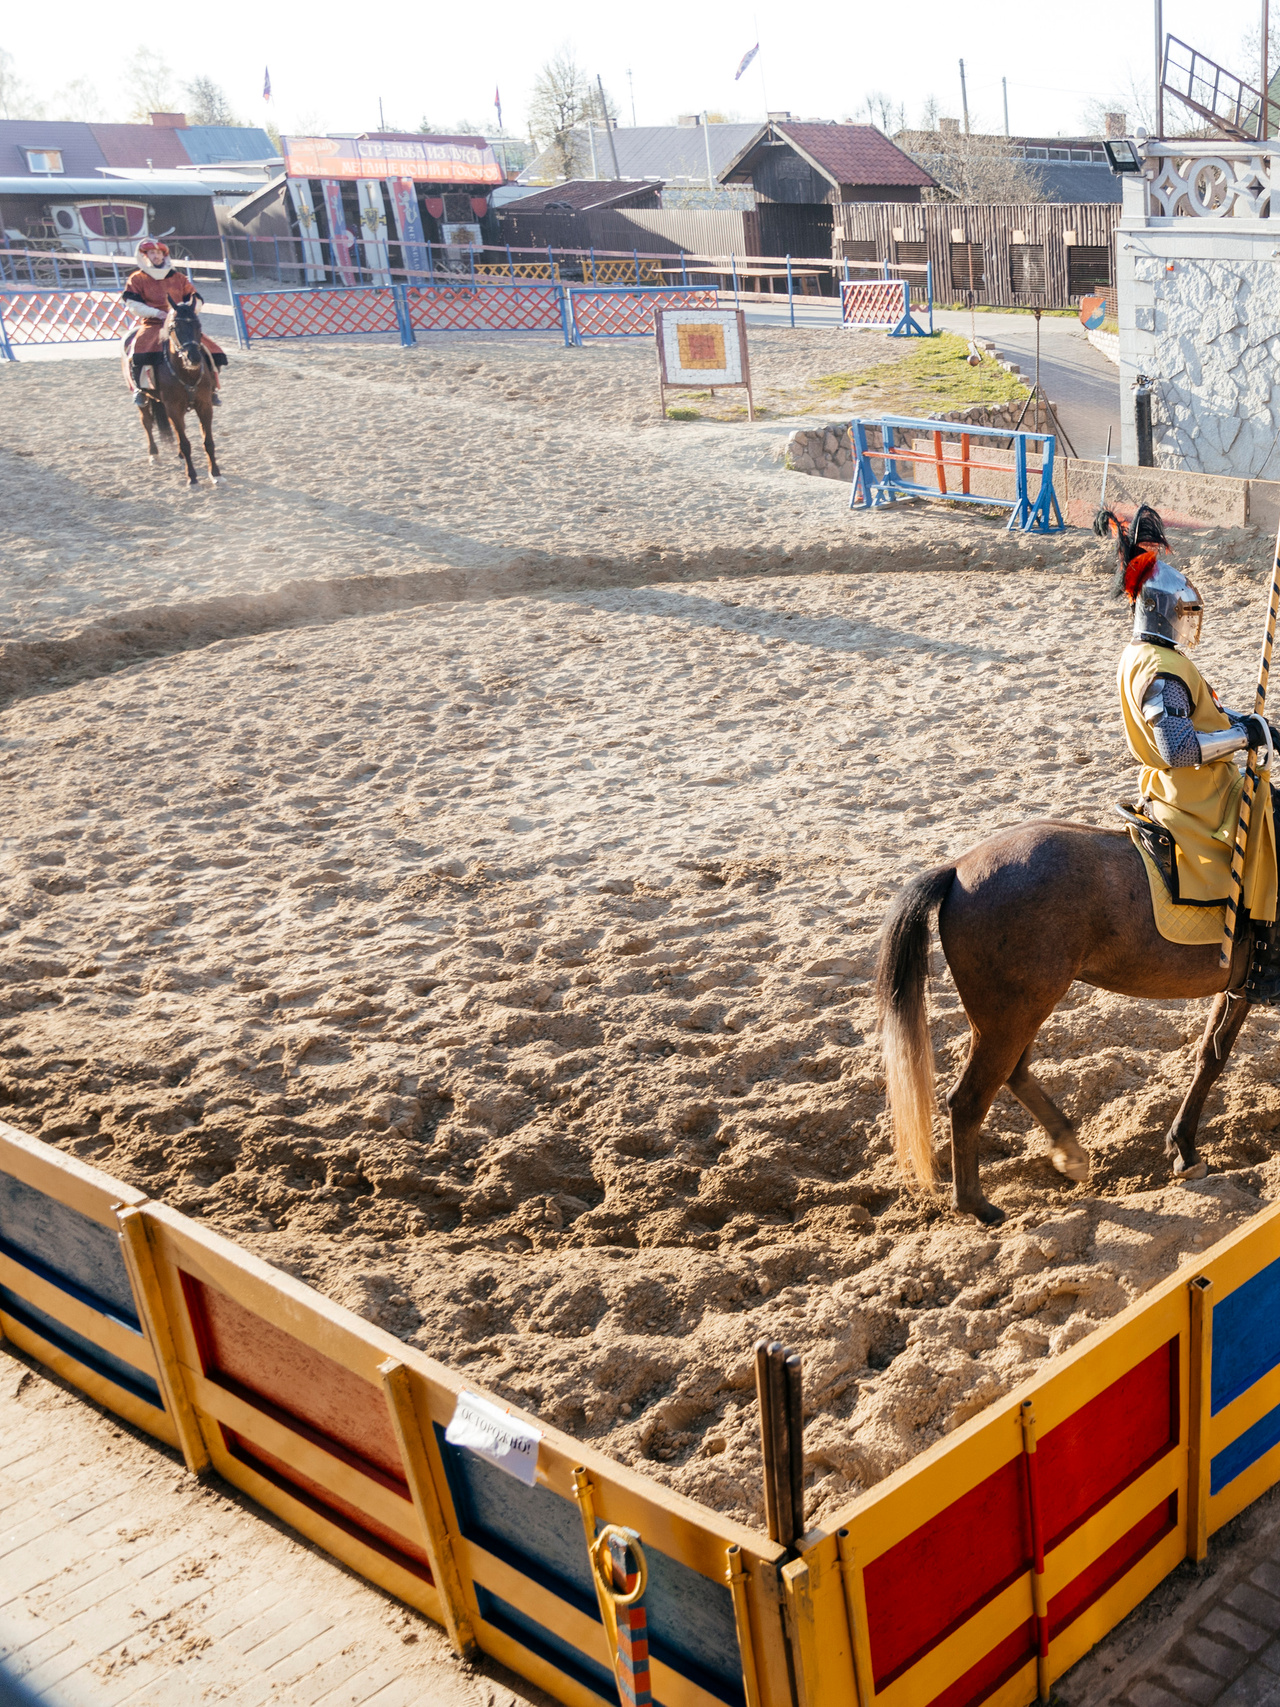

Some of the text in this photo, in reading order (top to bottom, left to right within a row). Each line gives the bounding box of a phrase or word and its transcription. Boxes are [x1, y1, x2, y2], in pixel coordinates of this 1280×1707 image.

[358, 144, 481, 164] СТРЕЛЬБА ИЗ ЛУКА
[342, 161, 399, 174] МЕТАНИЕ
[400, 163, 440, 176] КОПИЙ
[461, 1408, 532, 1455] ОСТОРОЖНО!
